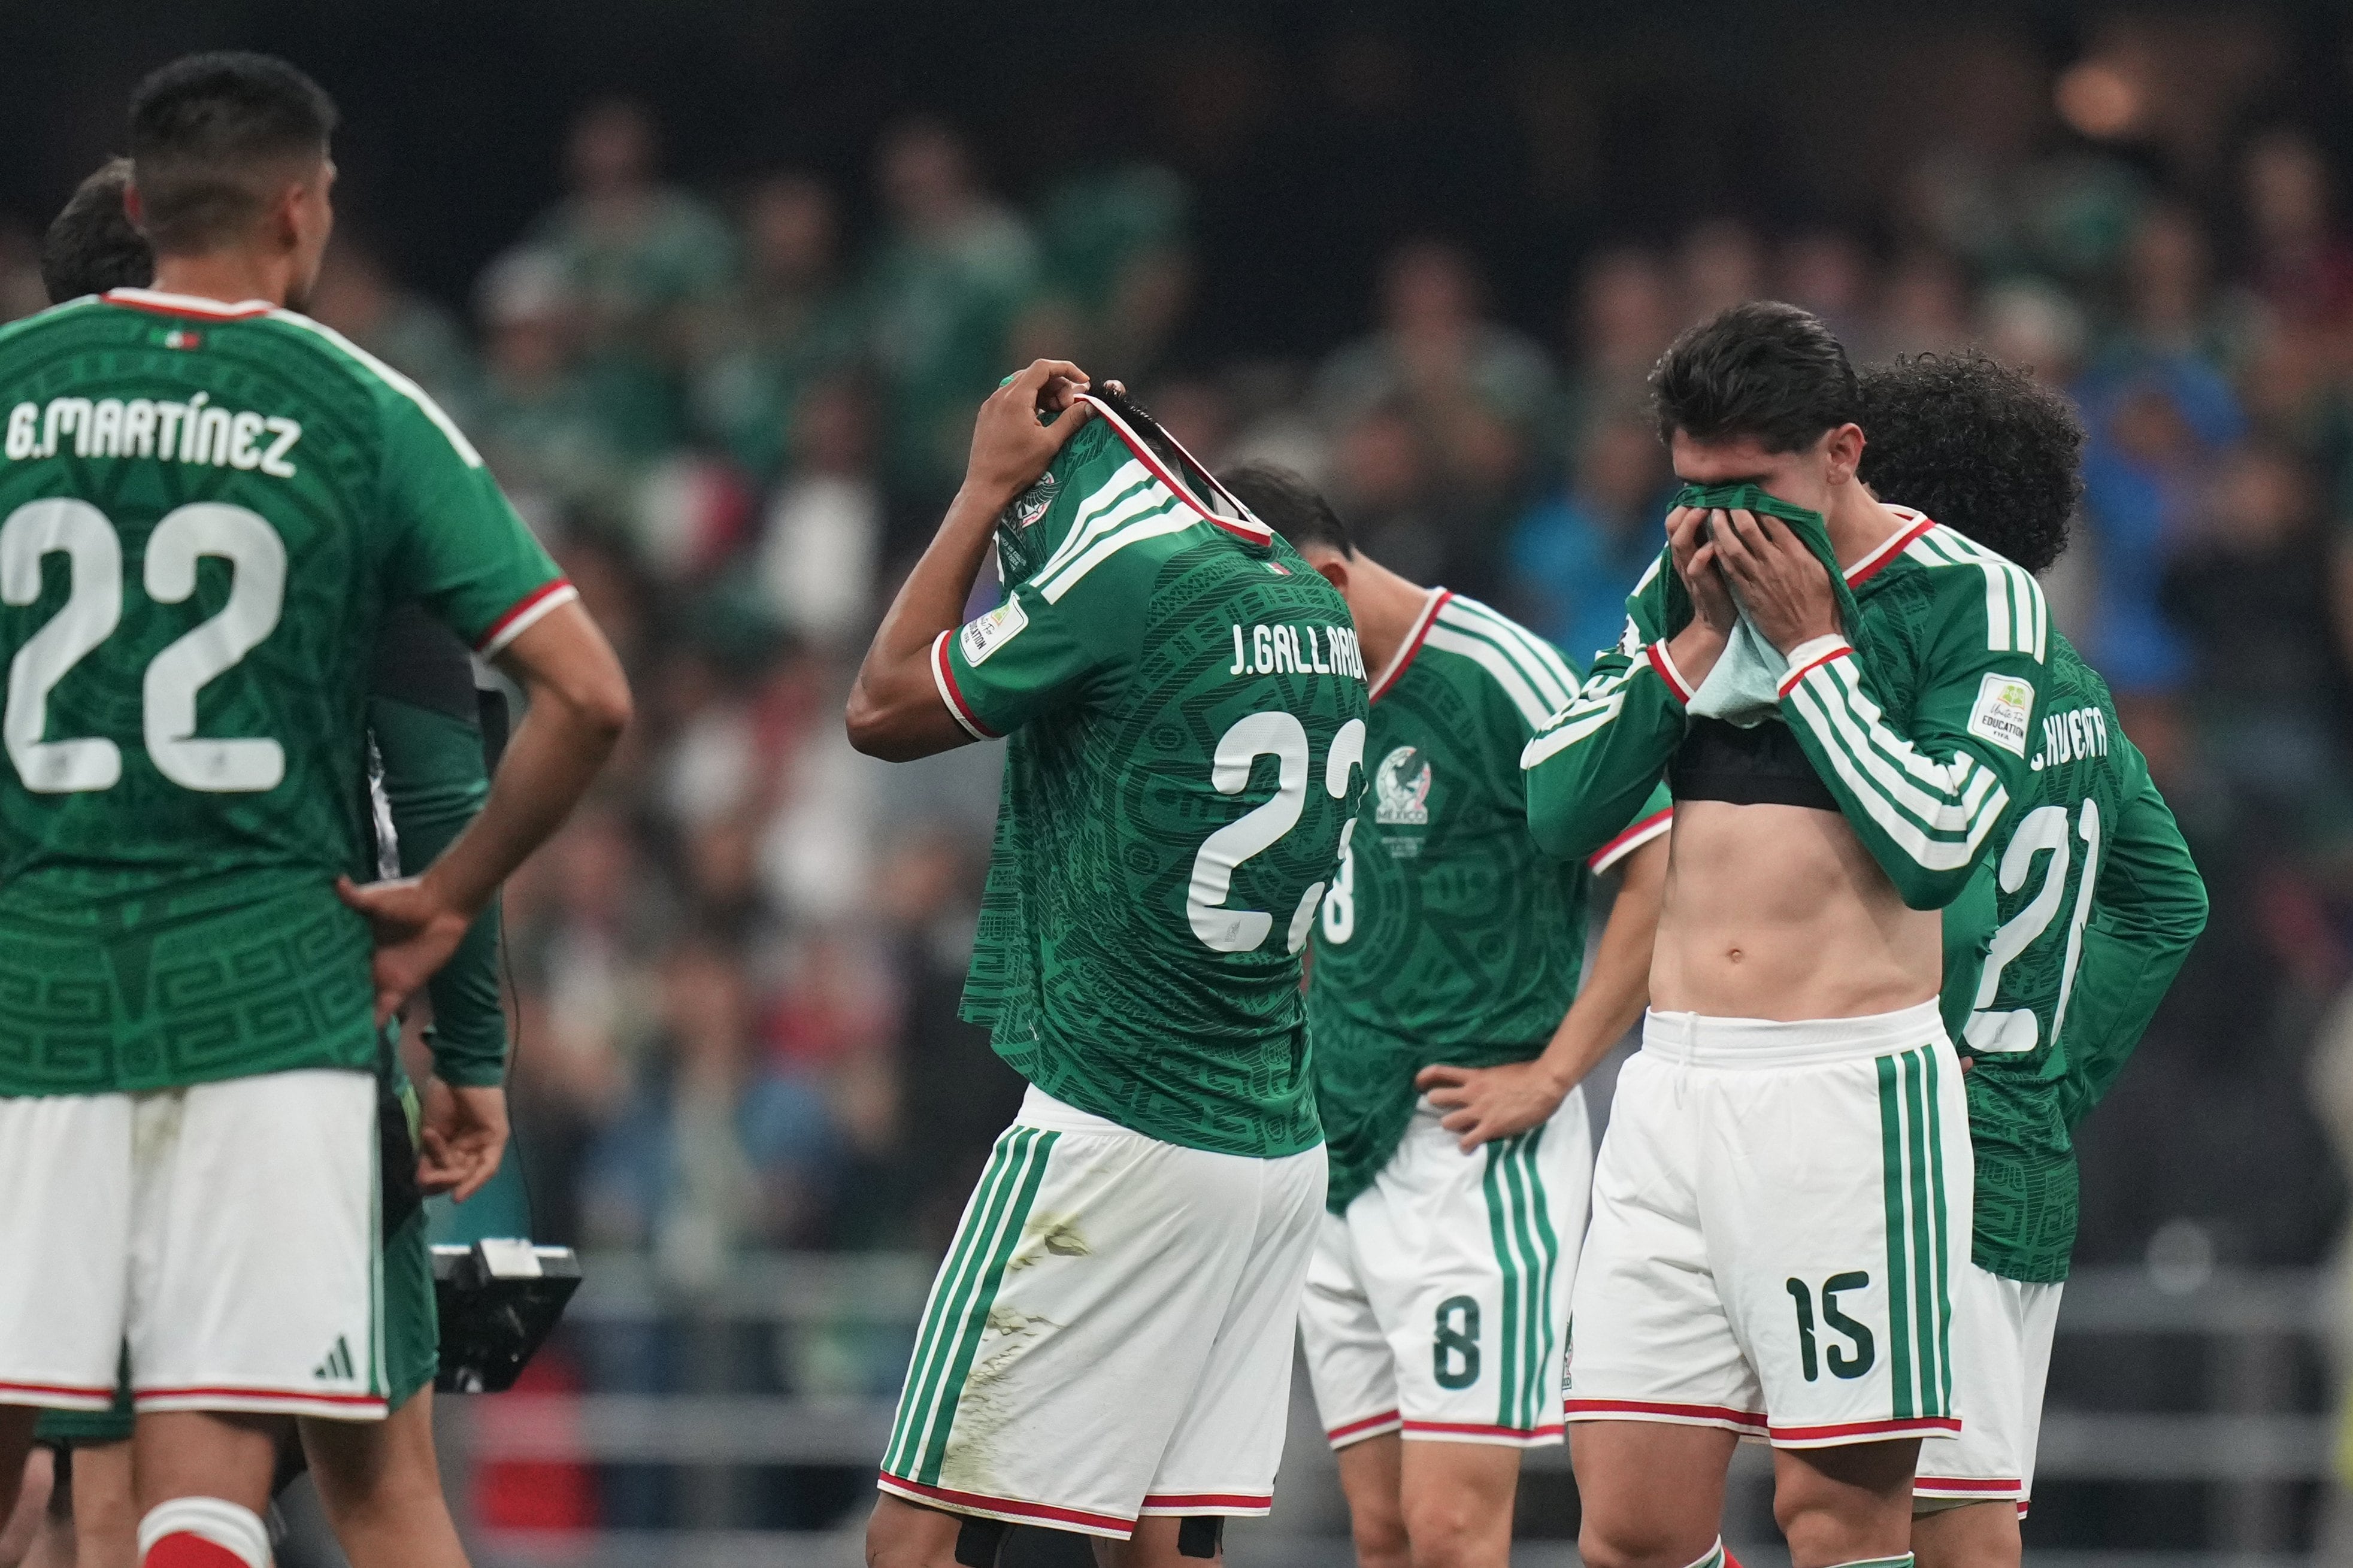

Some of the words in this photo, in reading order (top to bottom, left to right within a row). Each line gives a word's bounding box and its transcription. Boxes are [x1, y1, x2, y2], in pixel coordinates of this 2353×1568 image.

[5, 391, 301, 478] G.MARTÍNEZ
[0, 497, 286, 793] 22
[1230, 624, 1368, 681] J.GALLARD
[1982, 715, 2025, 739] EDUCATION
[1993, 731, 2009, 741] FIFA
[1963, 797, 2100, 1053] 21
[1433, 1294, 1481, 1390] 8
[1786, 1270, 1876, 1382] 15
